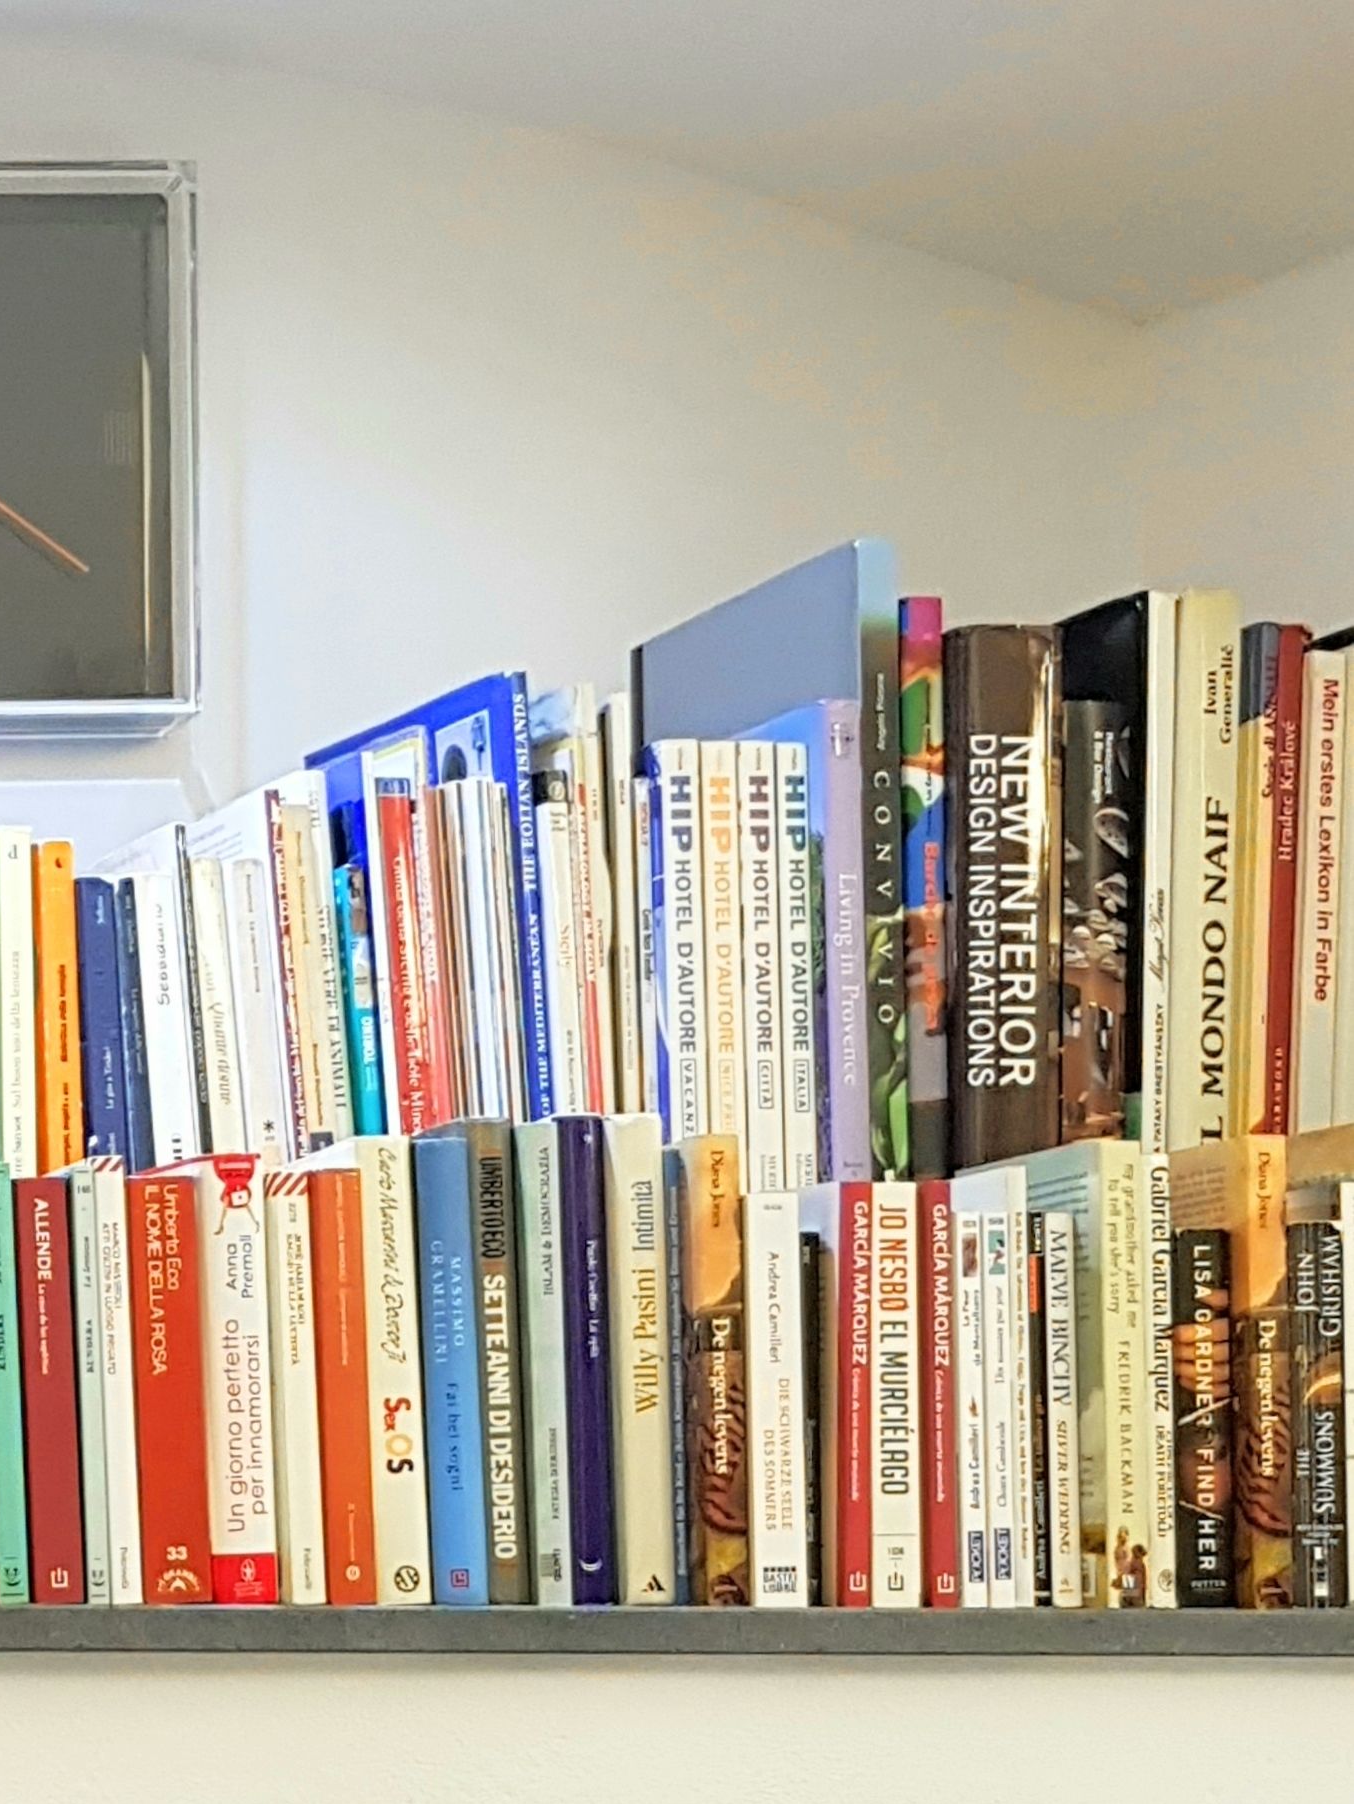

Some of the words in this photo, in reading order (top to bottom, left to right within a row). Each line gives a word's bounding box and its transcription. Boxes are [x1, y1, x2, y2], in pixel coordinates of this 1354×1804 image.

[1203, 669, 1218, 715] Ivan
[1321, 678, 1339, 732] Mein
[512, 692, 531, 773] ISLANDS
[968, 734, 997, 852] DESIGN
[999, 735, 1037, 847] NEW
[1319, 738, 1336, 808] erstes
[517, 777, 535, 849] EOLIAN
[670, 775, 692, 853] HIP
[708, 776, 732, 855] HIP
[748, 774, 770, 854] HIP
[784, 774, 806, 853] HIP
[1278, 793, 1294, 861] Hradec
[1202, 796, 1229, 905] NAIF
[1317, 816, 1335, 903] Lexikon
[673, 860, 693, 932] HOTEL
[712, 861, 730, 933] HOTEL
[752, 859, 771, 931] HOTEL
[789, 859, 808, 931] HOTEL
[833, 873, 858, 947] Living
[873, 770, 895, 1025] CONVIVIO
[1317, 911, 1334, 932] in
[528, 913, 548, 1053] MEDITERRANEAN
[676, 942, 696, 1054] D'AUTORE
[715, 943, 734, 1054] D'AUTORE
[753, 942, 773, 1053] D'AUTORE
[790, 941, 810, 1052] D'AUTORE
[839, 953, 857, 975] in
[967, 863, 997, 1087] INSPIRATIONS
[998, 863, 1038, 1087] INTERIOR
[1314, 938, 1332, 1003] Farbe
[842, 984, 861, 1086] Provence
[1201, 919, 1226, 1097] MONDO
[329, 1038, 347, 1109] ANIMALI
[759, 1064, 773, 1105] CITTÀ
[796, 1062, 808, 1109] ITALIA
[144, 1184, 160, 1199] IL
[163, 1183, 181, 1255] Umberto
[479, 1156, 504, 1228] UMBERTO
[630, 1180, 656, 1252] Intimità
[878, 1203, 908, 1229] JO
[1150, 1166, 1170, 1242] Gabriel
[33, 1199, 52, 1281] ALLENDE
[144, 1203, 162, 1257] NOME
[480, 1230, 505, 1259] ECO
[851, 1200, 871, 1268] GARCÍA
[932, 1203, 952, 1272] GARCÍA
[147, 1260, 165, 1319] DELLA
[165, 1256, 182, 1290] Eco
[224, 1242, 238, 1291] Anna
[238, 1234, 255, 1299] Premoli
[430, 1239, 449, 1365] GRAMELLINI
[449, 1255, 465, 1347] MASSIMO
[767, 1251, 780, 1299] Andrea
[1050, 1230, 1069, 1308] MAEVE
[1193, 1244, 1213, 1299] LISA
[1294, 1253, 1320, 1313] JOHN
[1318, 1234, 1344, 1337] GRISHAM
[483, 1274, 507, 1348] SETTE
[630, 1268, 657, 1341] Pasini
[710, 1318, 731, 1348] De
[851, 1273, 871, 1365] MÁRQUEZ
[879, 1320, 909, 1343] EL
[933, 1275, 954, 1366] MÁRQUEZ
[1257, 1319, 1277, 1349] De
[149, 1322, 168, 1376] ROSA
[222, 1318, 244, 1414] perfetto
[486, 1350, 511, 1403] ANNI
[633, 1349, 664, 1414] Willy
[708, 1351, 730, 1410] negen
[1052, 1318, 1073, 1406] BINCHY
[1118, 1340, 1132, 1414] FREDRIK
[1194, 1307, 1214, 1427] GARDNER
[1256, 1352, 1274, 1412] negen
[242, 1334, 264, 1470] innamorarsi
[487, 1410, 511, 1433] DI
[878, 1351, 915, 1495] MURCIÉLAGO
[225, 1421, 249, 1496] giorno
[445, 1444, 466, 1491] sogni
[713, 1413, 734, 1474] levens
[763, 1429, 775, 1457] DES
[1120, 1423, 1135, 1514] BACKMAN
[1196, 1447, 1216, 1507] FIND
[1259, 1414, 1278, 1477] levens
[1296, 1447, 1310, 1477] THE
[1312, 1410, 1337, 1515] SUMMONS
[227, 1503, 246, 1533] Un
[249, 1477, 268, 1515] per
[488, 1438, 518, 1559] DESIDERIO
[763, 1459, 777, 1531] SOMMERS
[1057, 1476, 1072, 1554] WEDDING
[166, 1546, 188, 1561] 33
[1197, 1518, 1217, 1570] HER
